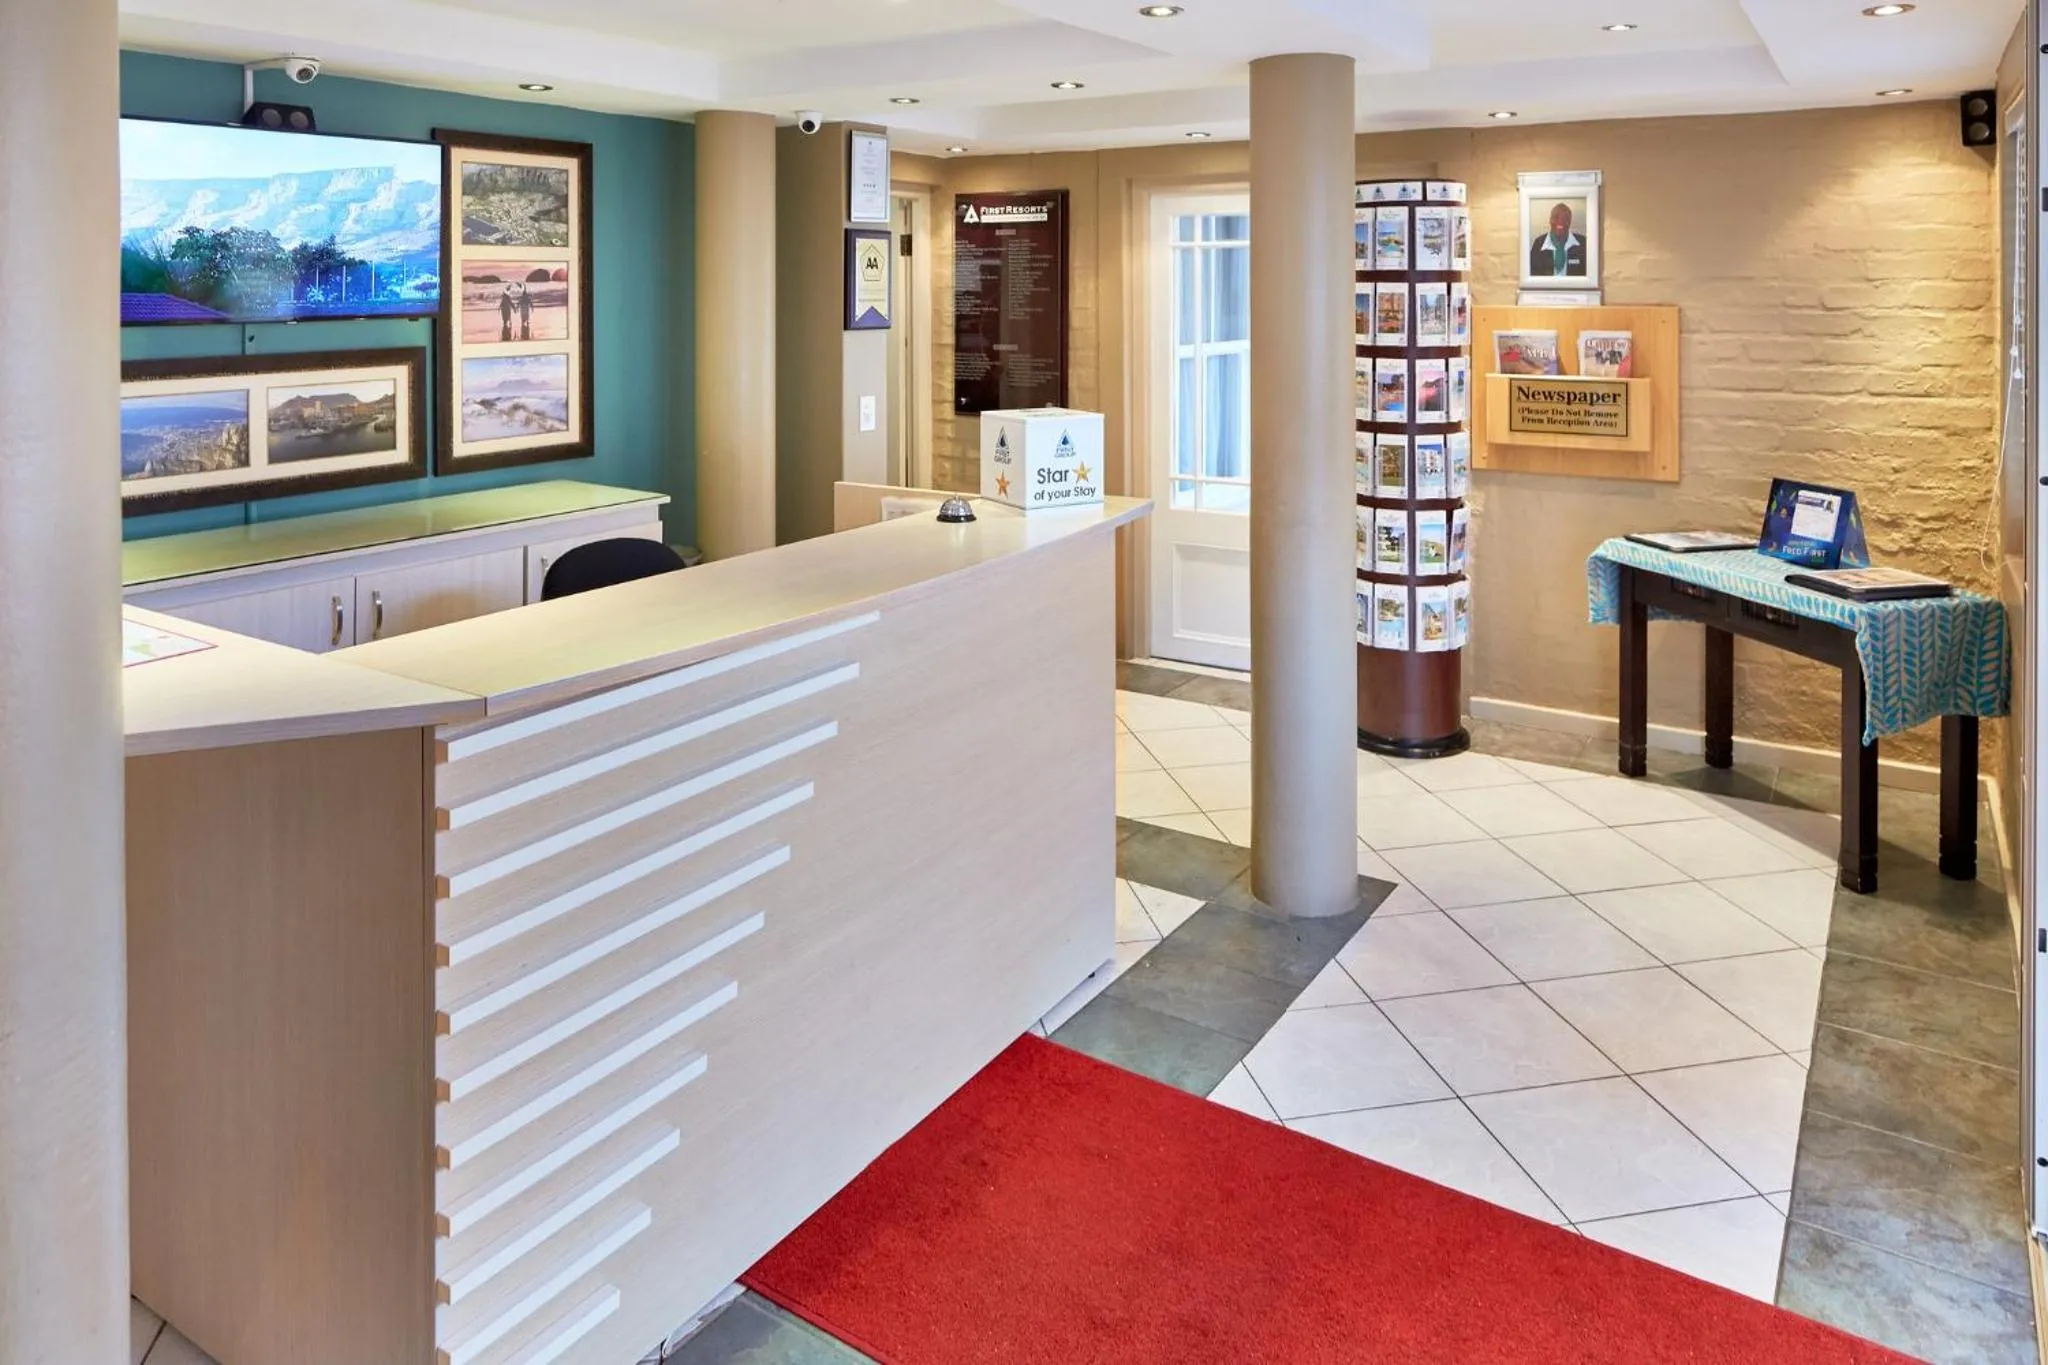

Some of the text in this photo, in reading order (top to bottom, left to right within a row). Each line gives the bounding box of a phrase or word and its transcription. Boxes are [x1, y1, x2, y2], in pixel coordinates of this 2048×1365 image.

[1005, 205, 1048, 214] RESORTS
[1516, 385, 1622, 406] Newspaper
[1551, 407, 1564, 416] Do
[1566, 408, 1581, 417] Not
[1583, 409, 1619, 418] Remove
[1521, 415, 1545, 424] From
[1546, 416, 1591, 428] Reception
[1037, 467, 1069, 485] Star
[1034, 486, 1096, 503] of your Stay
